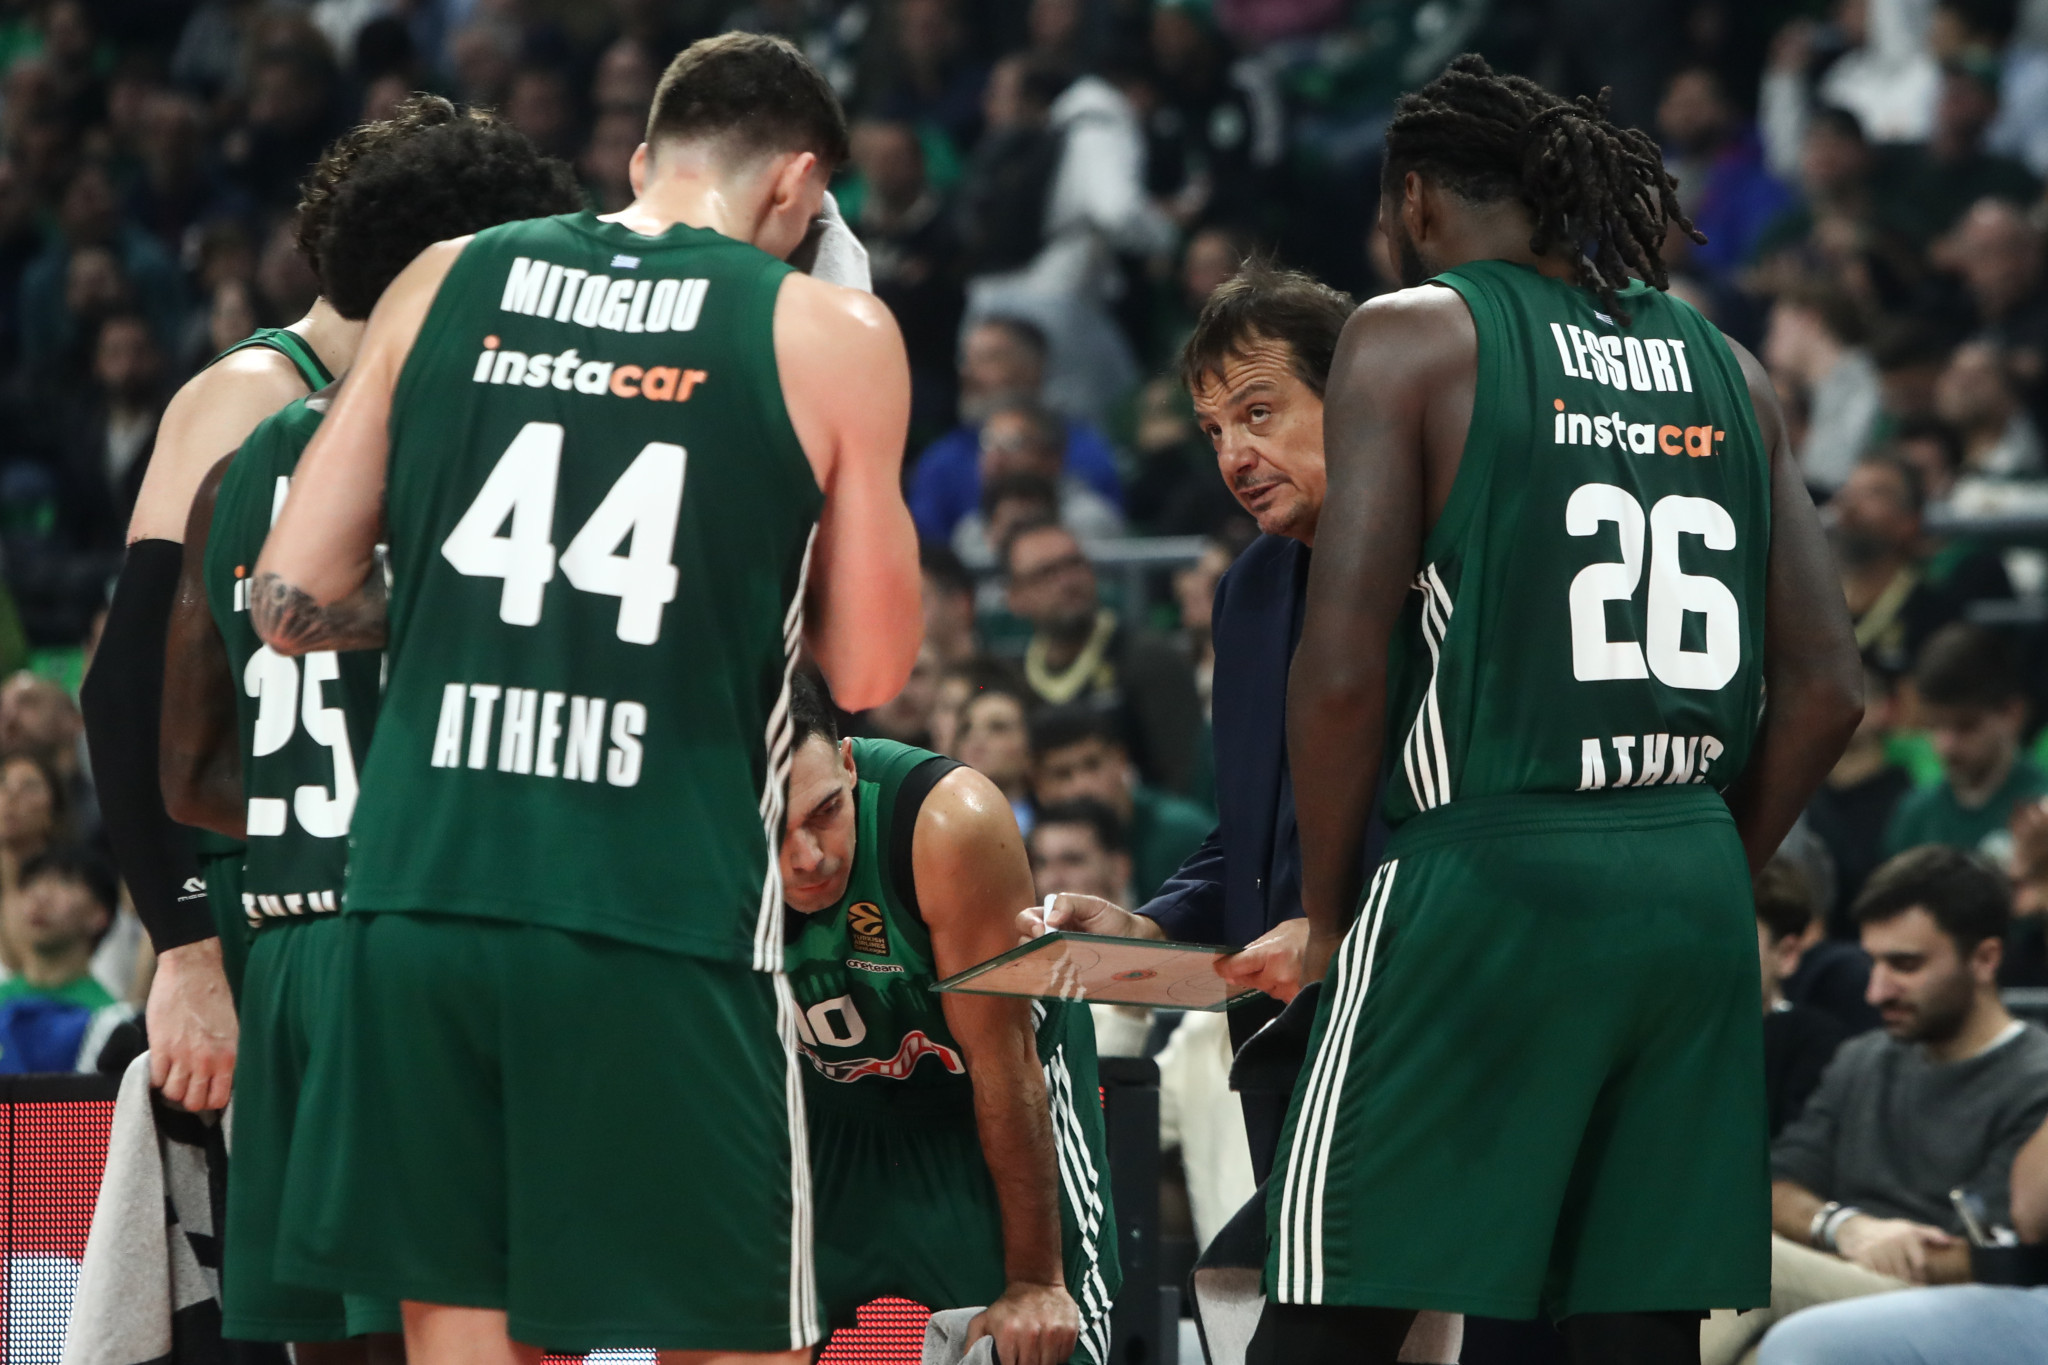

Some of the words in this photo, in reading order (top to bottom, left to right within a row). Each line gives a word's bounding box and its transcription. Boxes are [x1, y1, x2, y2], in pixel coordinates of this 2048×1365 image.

[500, 256, 710, 333] MITOGLOU
[473, 334, 709, 403] instacar
[1550, 322, 1693, 393] LESSORT
[441, 421, 688, 646] 44
[1565, 482, 1741, 691] 26
[243, 642, 360, 838] 25
[431, 682, 648, 788] ATHENS
[846, 959, 904, 973] oneteam
